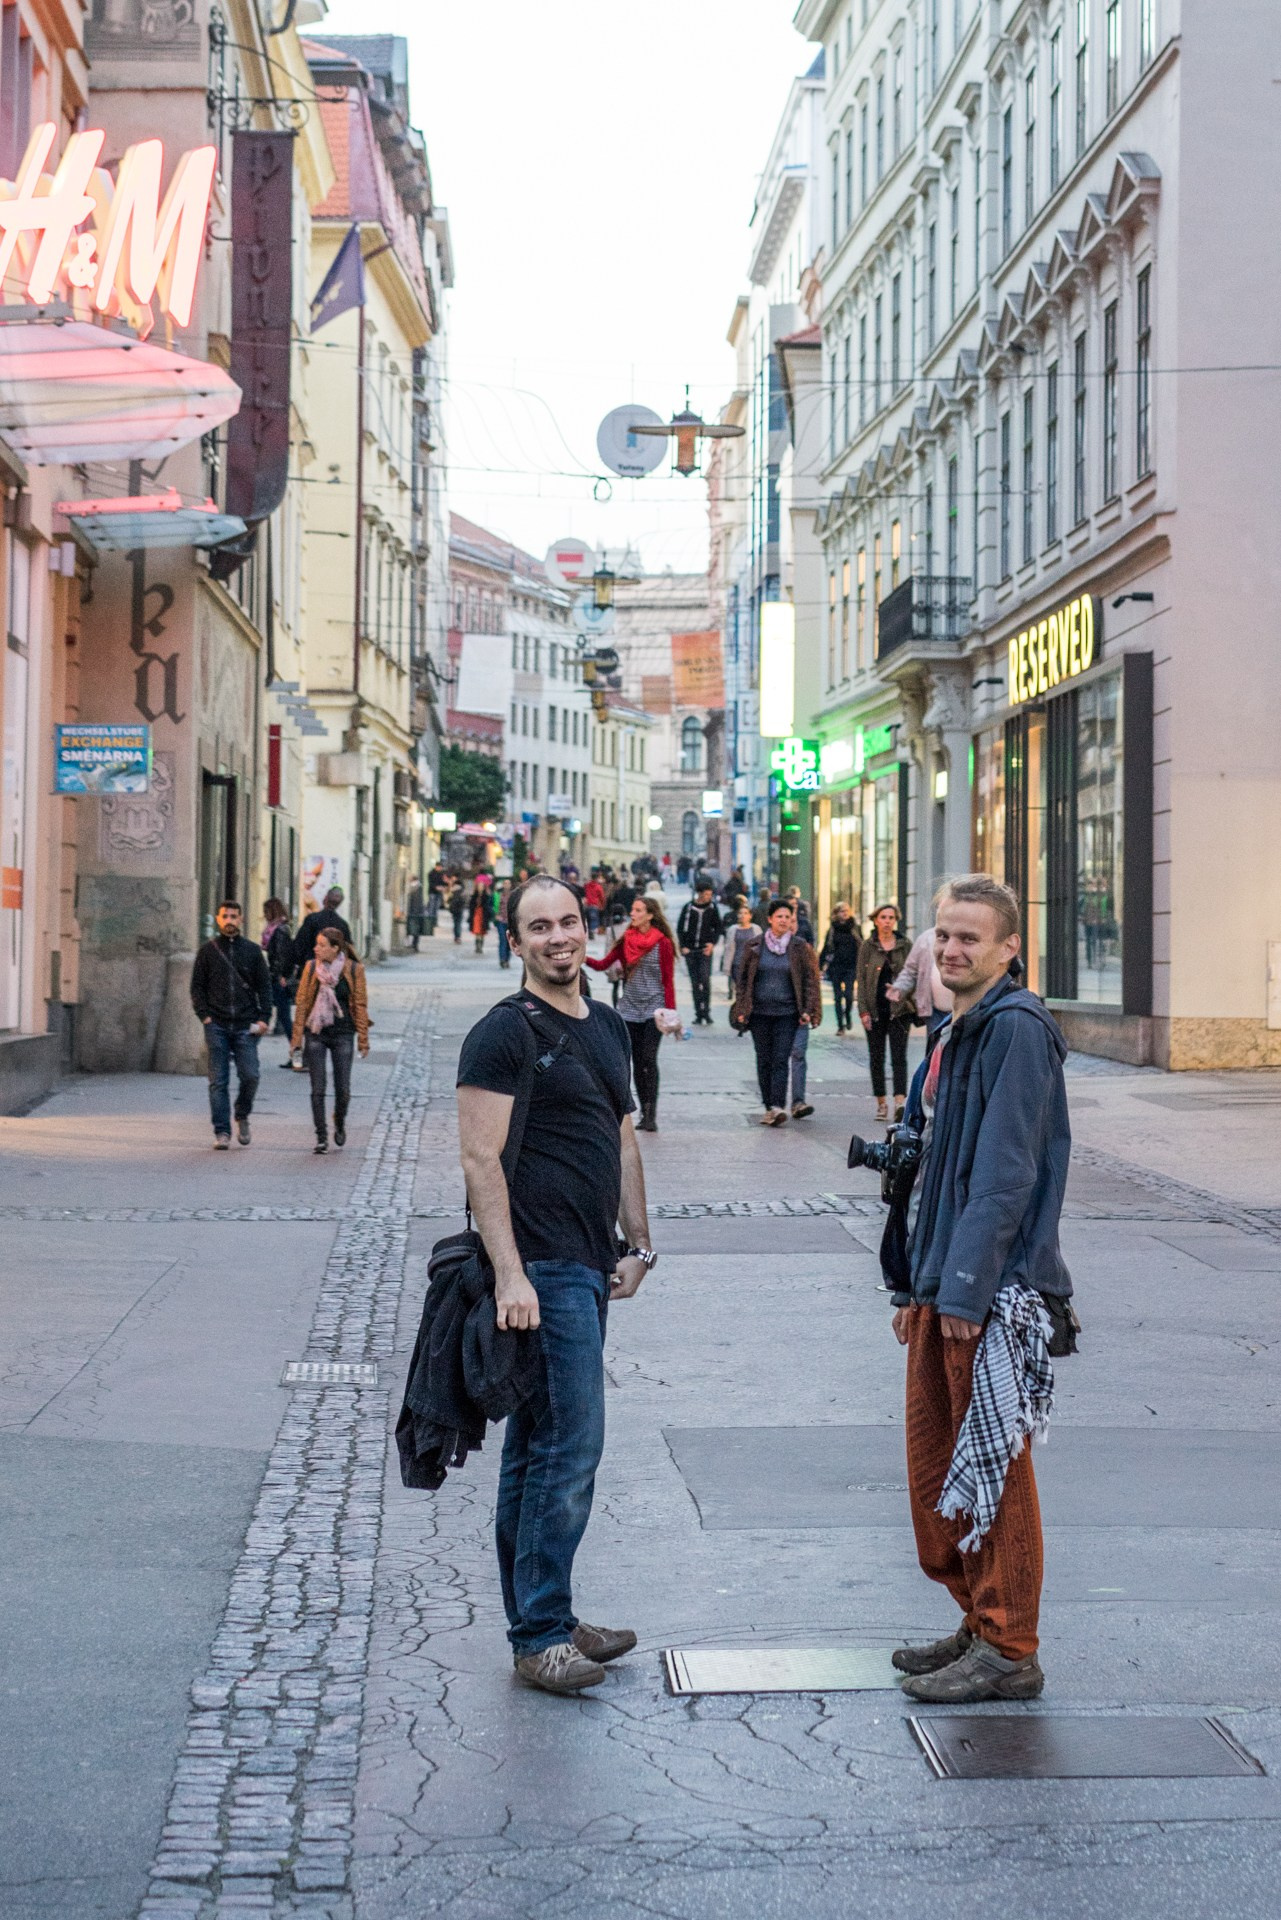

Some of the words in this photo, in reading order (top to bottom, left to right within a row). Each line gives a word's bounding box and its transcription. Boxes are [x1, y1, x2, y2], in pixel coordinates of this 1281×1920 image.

[0, 122, 215, 327] H&M
[1008, 593, 1093, 706] RESERVED
[61, 736, 144, 748] EXCHANGE
